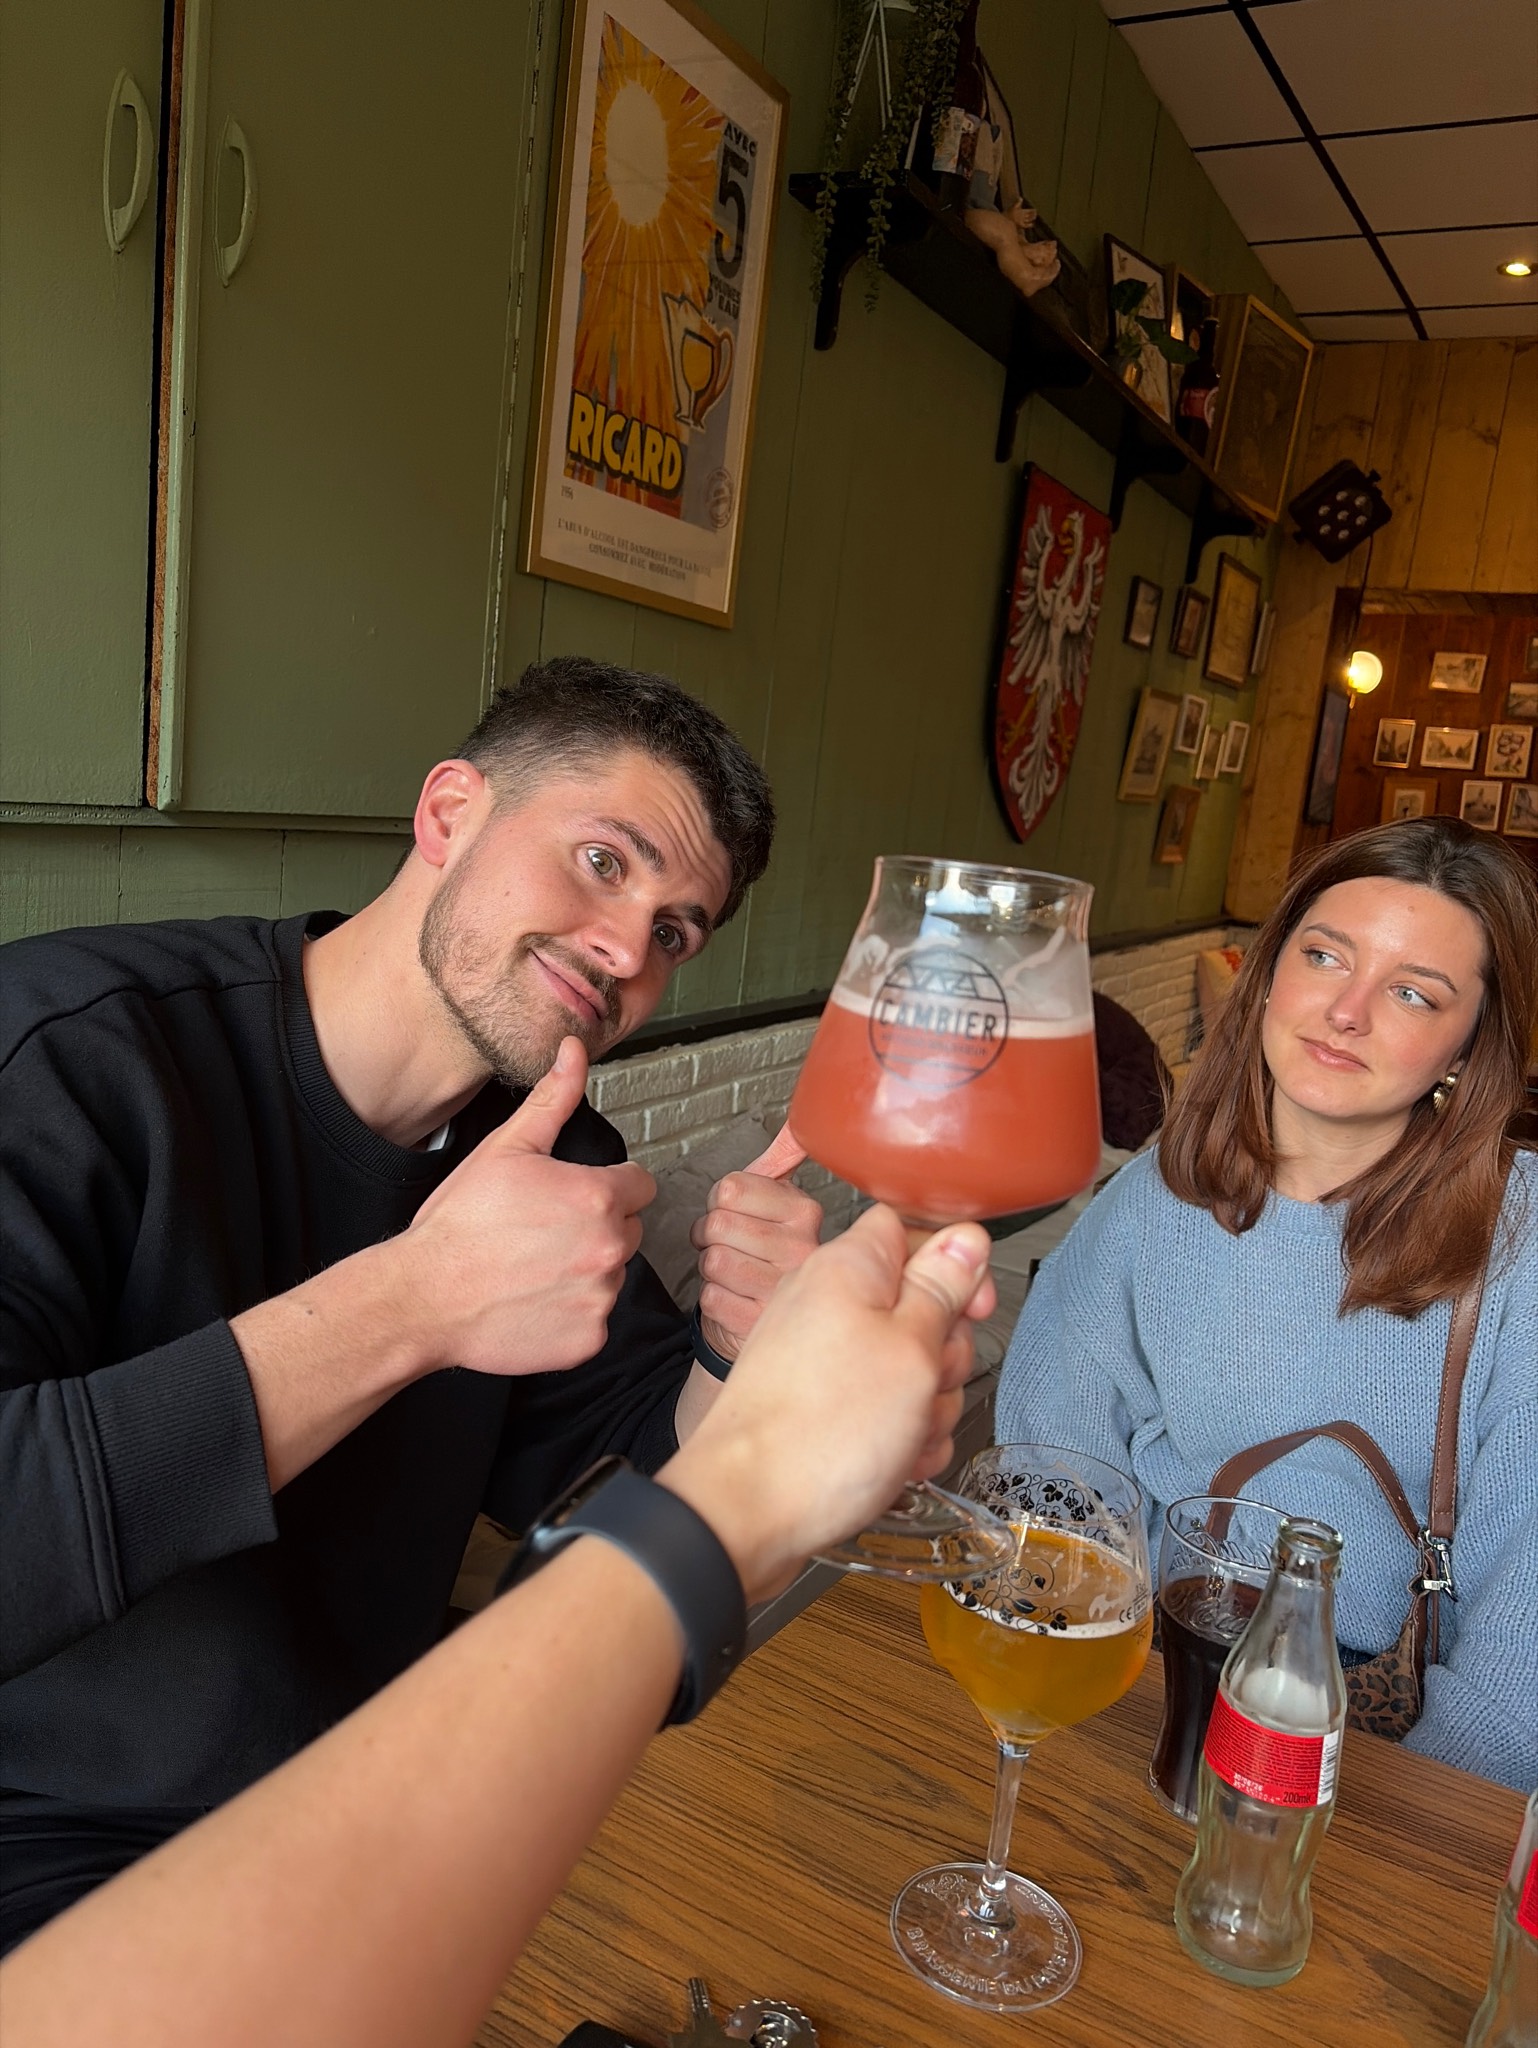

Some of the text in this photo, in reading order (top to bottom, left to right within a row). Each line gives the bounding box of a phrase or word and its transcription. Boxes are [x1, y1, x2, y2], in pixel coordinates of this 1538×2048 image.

[724, 122, 758, 158] AVEC
[714, 144, 750, 279] 5
[707, 287, 740, 320] D'EAU
[568, 392, 684, 493] RICARD
[879, 997, 998, 1042] CAMBIER
[1014, 1884, 1070, 1955] FLAMAND
[906, 1926, 998, 1996] BRASSERIE
[1002, 1976, 1034, 1996] DU
